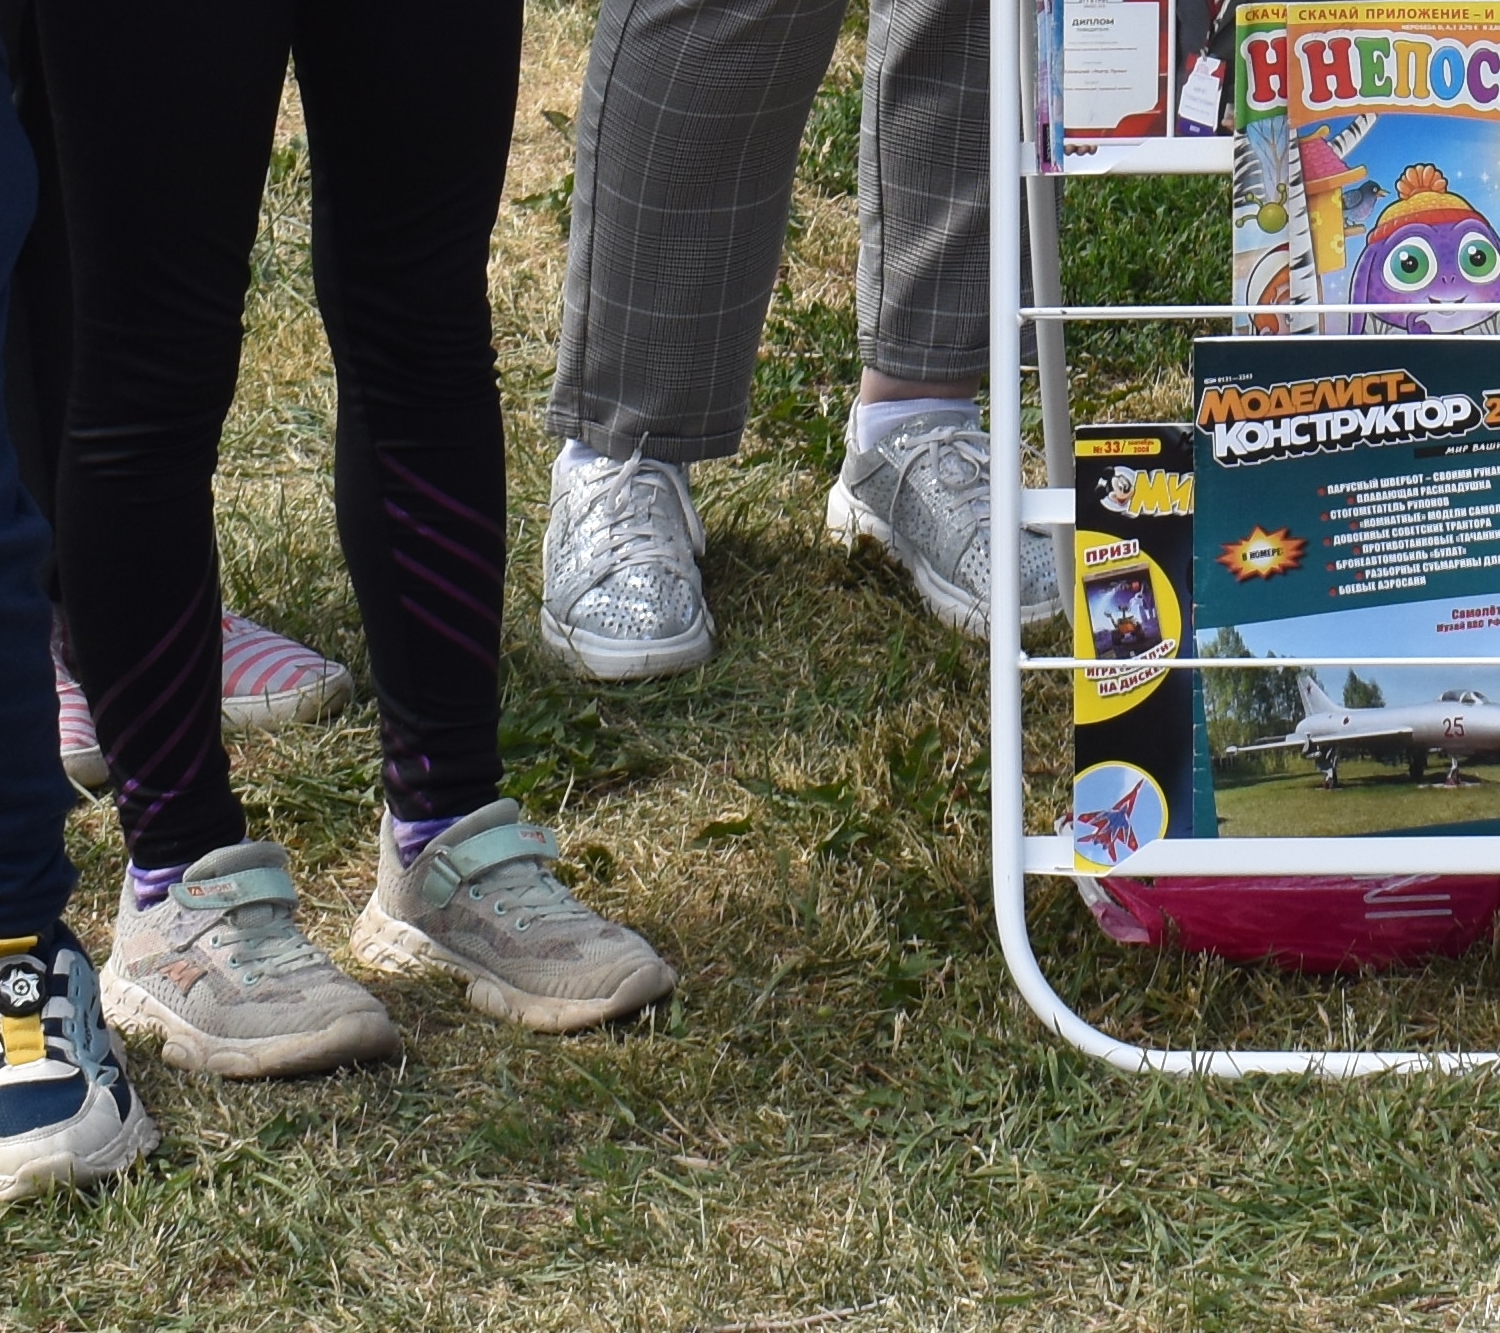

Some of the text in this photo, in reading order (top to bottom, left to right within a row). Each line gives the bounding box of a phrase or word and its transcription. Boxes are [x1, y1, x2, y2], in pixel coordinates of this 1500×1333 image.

[1298, 7, 1360, 20] СКАЧАЙ
[1366, 8, 1470, 20] ПРИЛОЖЕНИЕ
[1484, 9, 1495, 20] И
[1199, 369, 1417, 424] МОДЕЛИСТ-
[1214, 395, 1474, 458] КОНСТРУКТОР
[1444, 445, 1468, 456] МИР
[1085, 541, 1139, 564] ПРИЗ!
[1442, 716, 1465, 737] 25
